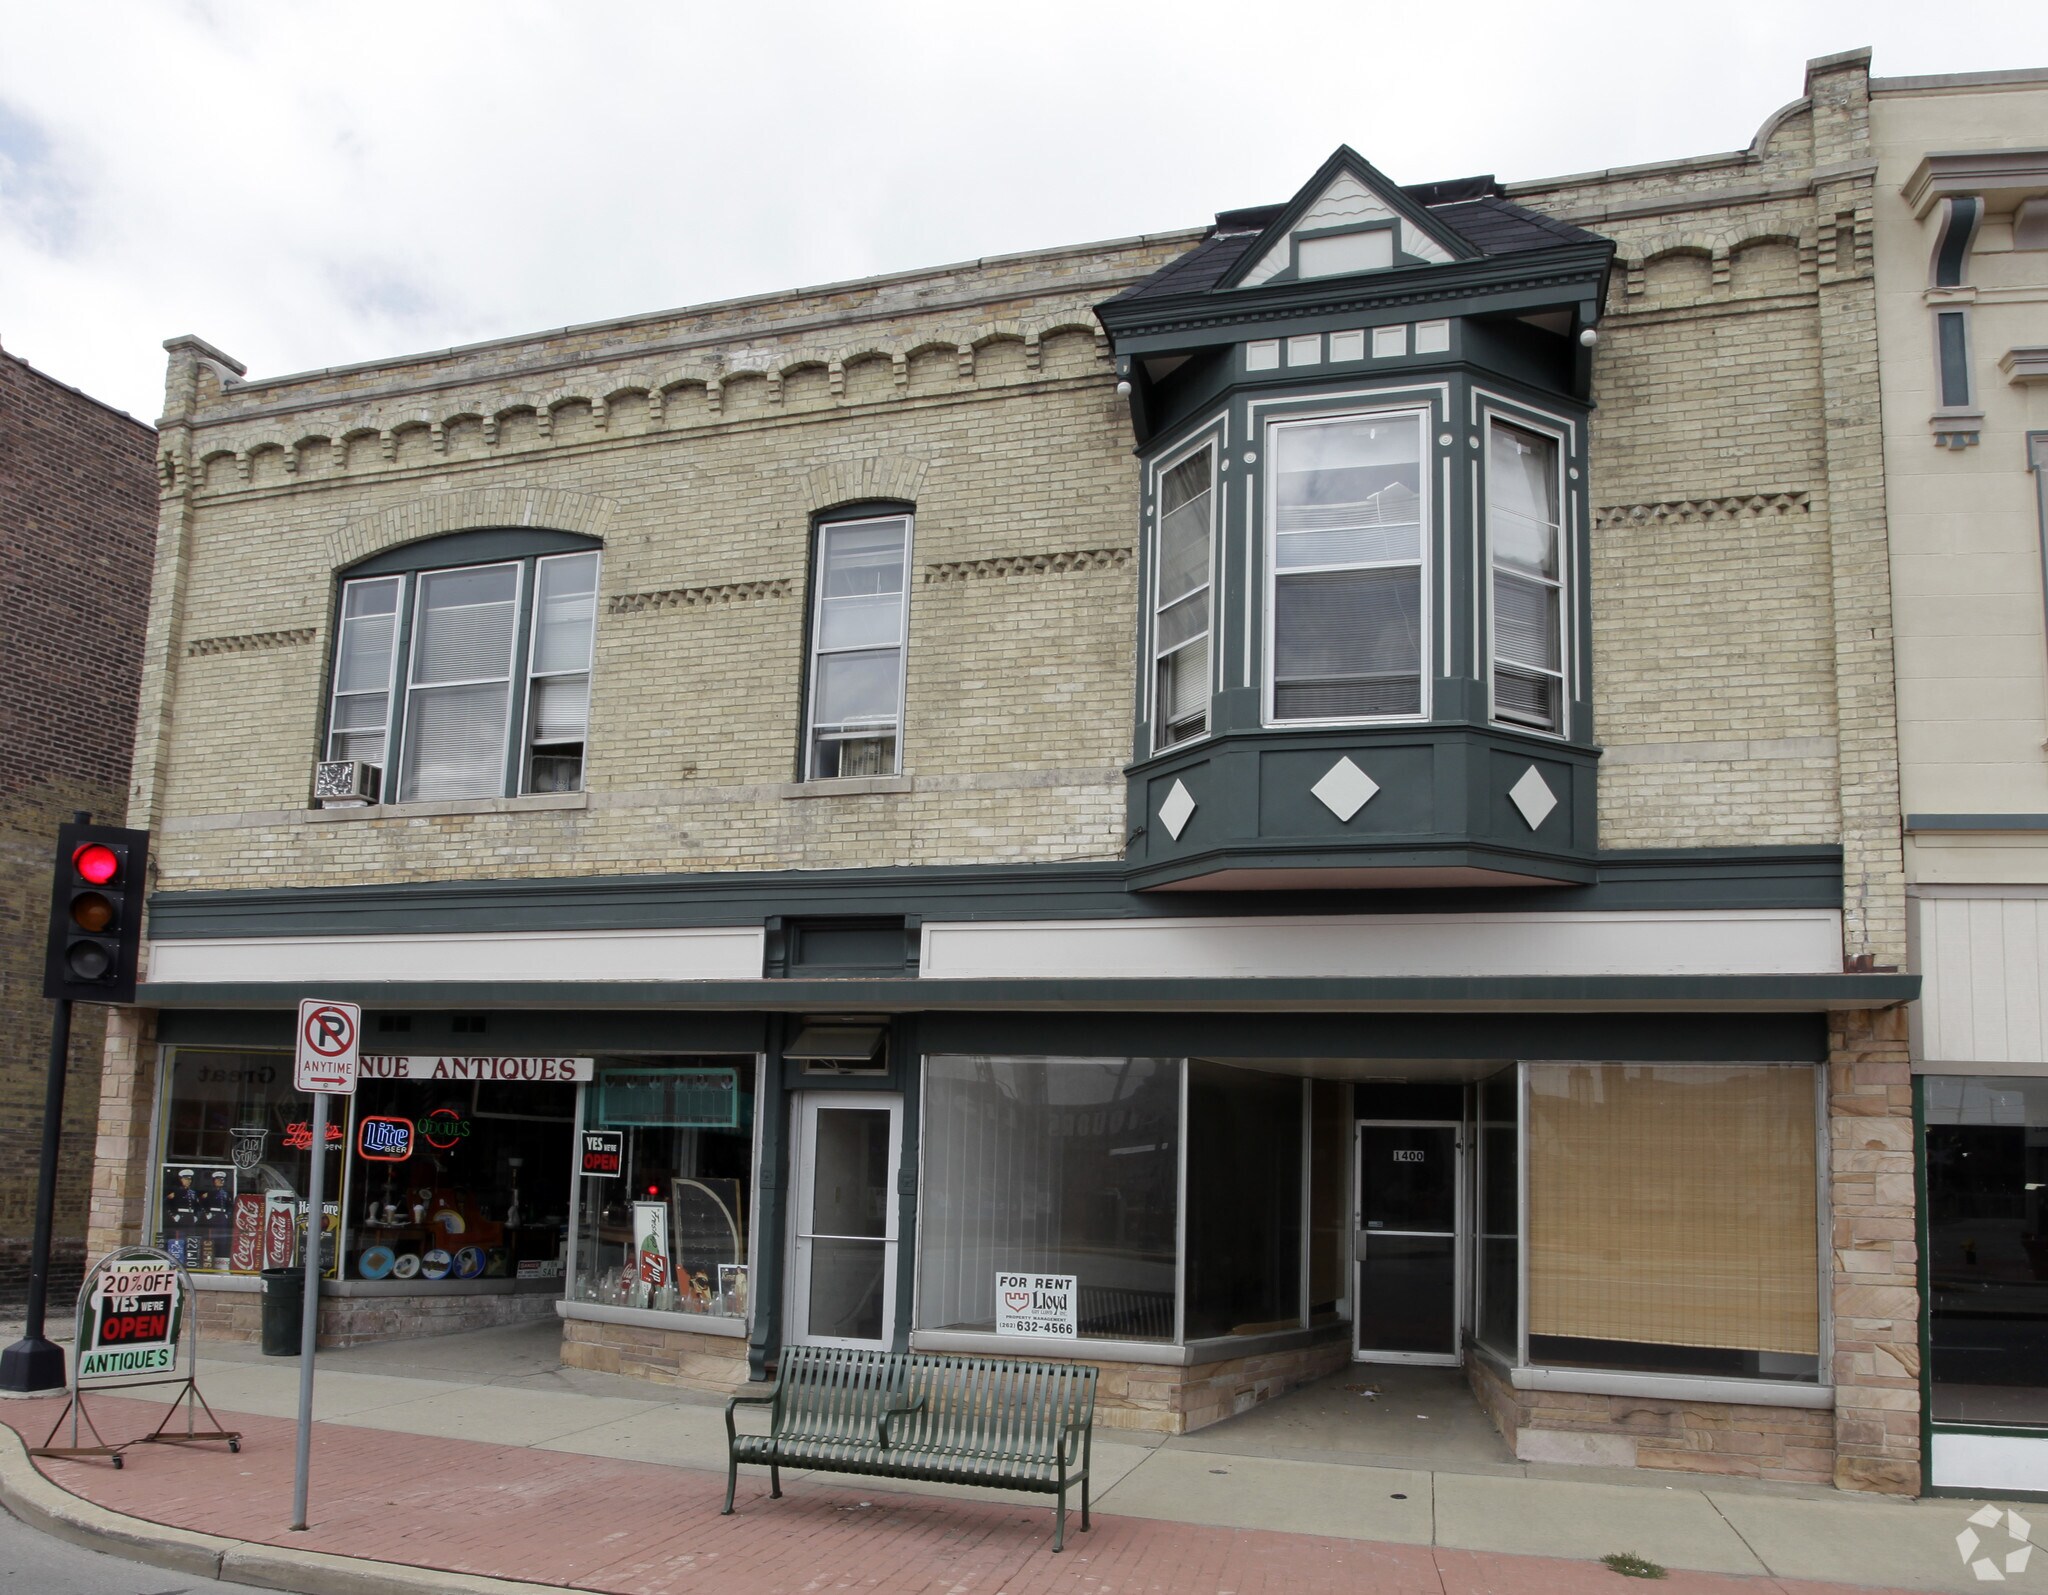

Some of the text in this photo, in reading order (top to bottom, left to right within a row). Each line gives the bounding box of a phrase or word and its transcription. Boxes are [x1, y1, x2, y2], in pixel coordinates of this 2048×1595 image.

[304, 1060, 352, 1075] ANYTIME
[359, 1057, 576, 1081] NUE ANTIQUES
[364, 1122, 408, 1151] Lite
[586, 1137, 602, 1151] YES
[385, 1145, 407, 1153] BEER
[1395, 1151, 1424, 1161] 1400
[235, 1150, 258, 1167] Style
[584, 1154, 618, 1169] OPEN
[542, 1268, 556, 1277] SAL
[1000, 1276, 1072, 1290] FOR RENT
[112, 1296, 164, 1312] YES WE'RE
[1032, 1290, 1067, 1315] Lloyd
[103, 1315, 165, 1340] OPEN
[1017, 1320, 1073, 1334] 632-4566
